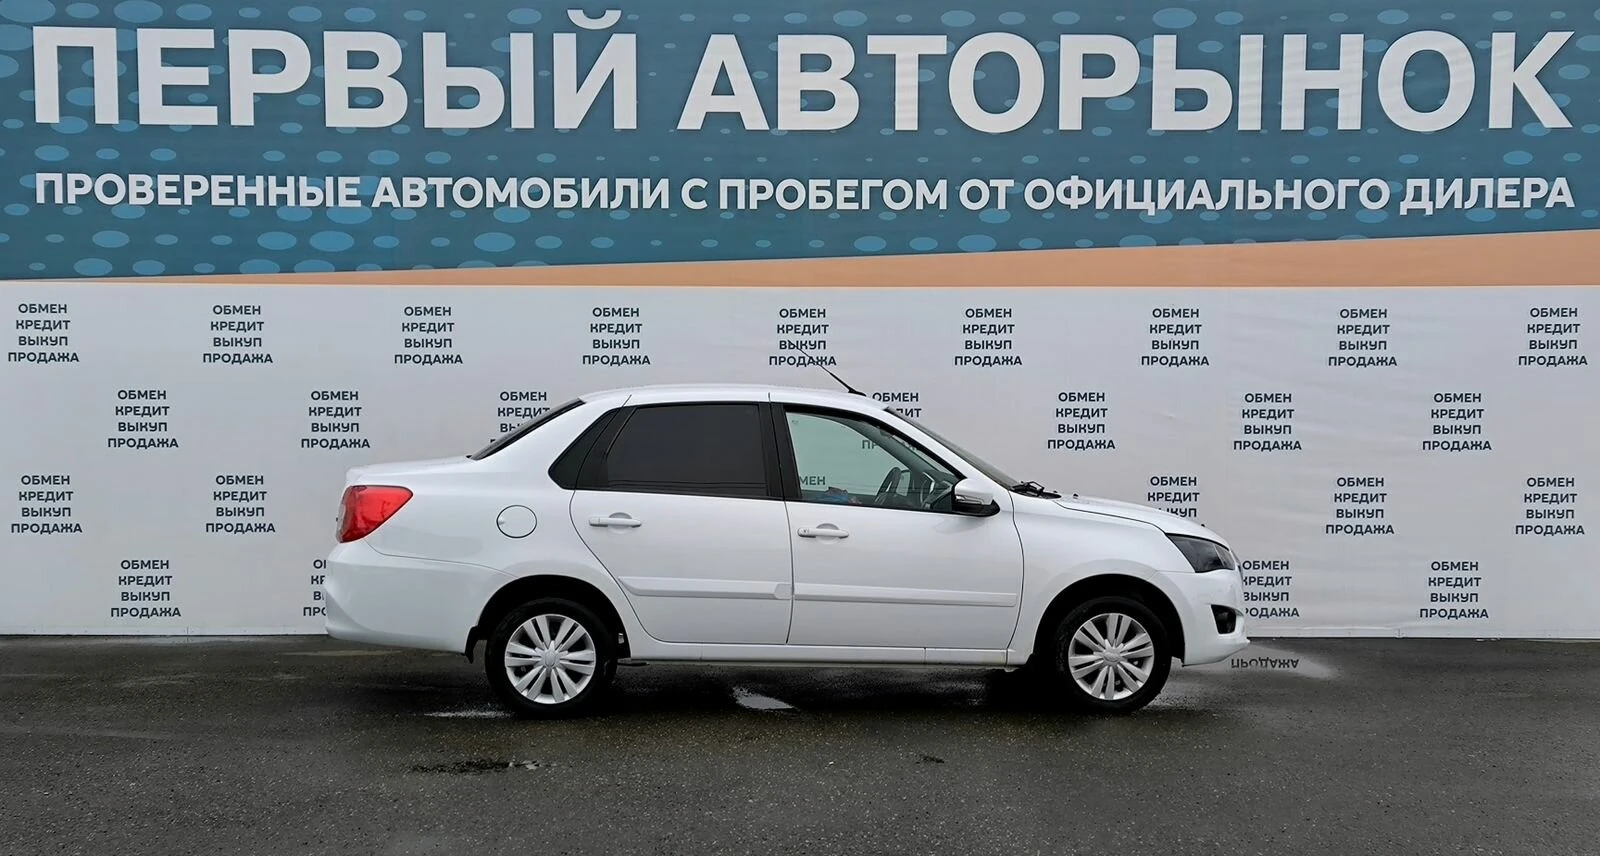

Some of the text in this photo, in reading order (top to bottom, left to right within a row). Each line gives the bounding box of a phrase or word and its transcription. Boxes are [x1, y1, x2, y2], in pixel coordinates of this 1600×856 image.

[33, 10, 1574, 133] ПЕРВЫЙ АВТОРЫНОК
[35, 173, 1575, 216] ПРОВЕРЕННЫЕ АВТОМОБИЛИ С ПРОБЕГОМ ОТ ОФИЦИАЛЬНОГО ДИЛЕРА
[18, 303, 67, 313] ОБМЕН
[213, 305, 261, 315] ОБМЕН
[404, 306, 451, 316] ОБМЕН
[592, 307, 639, 317] ОБМЕН
[779, 308, 826, 318] ОБМЕН
[965, 308, 1012, 318] ОБМЕН
[1152, 308, 1199, 318] ОБМЕН
[1340, 309, 1387, 318] ОБМЕН
[1530, 308, 1577, 317] ОБМЕН
[16, 320, 71, 332] КРЕДИТ
[211, 321, 264, 333] КРЕДИТ
[402, 322, 455, 334] КРЕДИТ
[590, 323, 642, 335] КРЕДИТ
[777, 324, 829, 336] КРЕДИТ
[963, 324, 1015, 335] КРЕДИТ
[1150, 324, 1202, 336] КРЕДИТ
[1337, 325, 1390, 336] КРЕДИТ
[1527, 324, 1581, 335] КРЕДИТ
[19, 336, 68, 346] ВЫКУП
[213, 337, 262, 347] ВЫКУП
[405, 338, 452, 348] ВЫКУП
[593, 339, 640, 349] ВЫКУП
[779, 340, 826, 350] ВЫКУП
[965, 340, 1012, 349] ВЫКУП
[1152, 340, 1199, 350] ВЫКУП
[1339, 341, 1387, 350] ВЫКУП
[1529, 340, 1577, 349] ВЫКУП
[8, 352, 79, 364] ПРОДАЖА
[203, 353, 273, 365] ПРОДАЖА
[395, 354, 463, 366] ПРОДАЖА
[583, 355, 650, 366] ПРОДАЖА
[769, 356, 837, 367] ПРОДАЖА
[955, 356, 1022, 367] ПРОДАЖА
[1141, 356, 1209, 367] ПРОДАЖА
[1329, 356, 1397, 368] ПРОДАЖА
[1519, 356, 1588, 367] ПРОДАЖА
[118, 390, 166, 400] ОБМЕН
[311, 391, 358, 400] ОБМЕН
[500, 391, 547, 401] ОБМЕН
[872, 392, 919, 402] ОБМЕН
[1058, 392, 1105, 402] ОБМЕН
[1245, 393, 1291, 403] ОБМЕН
[1434, 393, 1481, 403] ОБМЕН
[116, 406, 170, 417] КРЕДИТ
[309, 407, 362, 418] КРЕДИТ
[1056, 408, 1108, 419] КРЕДИТ
[1242, 409, 1295, 420] КРЕДИТ
[1431, 409, 1484, 420] КРЕДИТ
[118, 422, 167, 432] ВЫКУП
[312, 423, 359, 432] ВЫКУП
[1058, 424, 1105, 433] ВЫКУП
[1244, 425, 1291, 434] ВЫКУП
[1433, 425, 1481, 434] ВЫКУП
[108, 438, 179, 449] ПРОДАЖА
[301, 439, 370, 450] ПРОДАЖА
[1048, 439, 1115, 451] ПРОДАЖА
[1234, 441, 1302, 452] ПРОДАЖА
[1423, 441, 1492, 452] ПРОДАЖА
[21, 475, 70, 485] ОБМЕН
[216, 475, 263, 485] ОБМЕН
[799, 475, 826, 486] МЕН
[1150, 476, 1197, 486] ОБМЕН
[1337, 477, 1384, 487] ОБМЕН
[1527, 477, 1574, 487] ОБМЕН
[19, 491, 74, 503] КРЕДИТ
[214, 491, 267, 503] КРЕДИТ
[1148, 492, 1200, 503] КРЕДИТ
[1334, 493, 1387, 504] КРЕДИТ
[1524, 493, 1577, 505] КРЕДИТ
[22, 507, 71, 517] ВЫКУП
[216, 507, 264, 517] ВЫКУП
[1158, 507, 1198, 518] КУП
[1336, 509, 1384, 518] ВЫКУП
[1526, 509, 1574, 519] ВЫКУП
[11, 523, 82, 535] ПРОДАЖА
[206, 523, 275, 534] ПРОДАЖА
[1326, 524, 1394, 536] ПРОДАЖА
[1516, 525, 1585, 536] ПРОДАЖА
[121, 560, 169, 569] ОБМЕН
[1242, 560, 1290, 571] ОБМЕН
[1431, 561, 1478, 571] ОБМЕН
[119, 576, 172, 587] КРЕДИТ
[1428, 577, 1482, 588] КРЕДИТ
[121, 592, 170, 601] ВЫКУП
[1430, 593, 1478, 602] ВЫКУП
[111, 607, 181, 619] ПРОДАЖА
[1245, 607, 1300, 619] ОДАЖА
[1420, 609, 1488, 620] ПРОДАЖА
